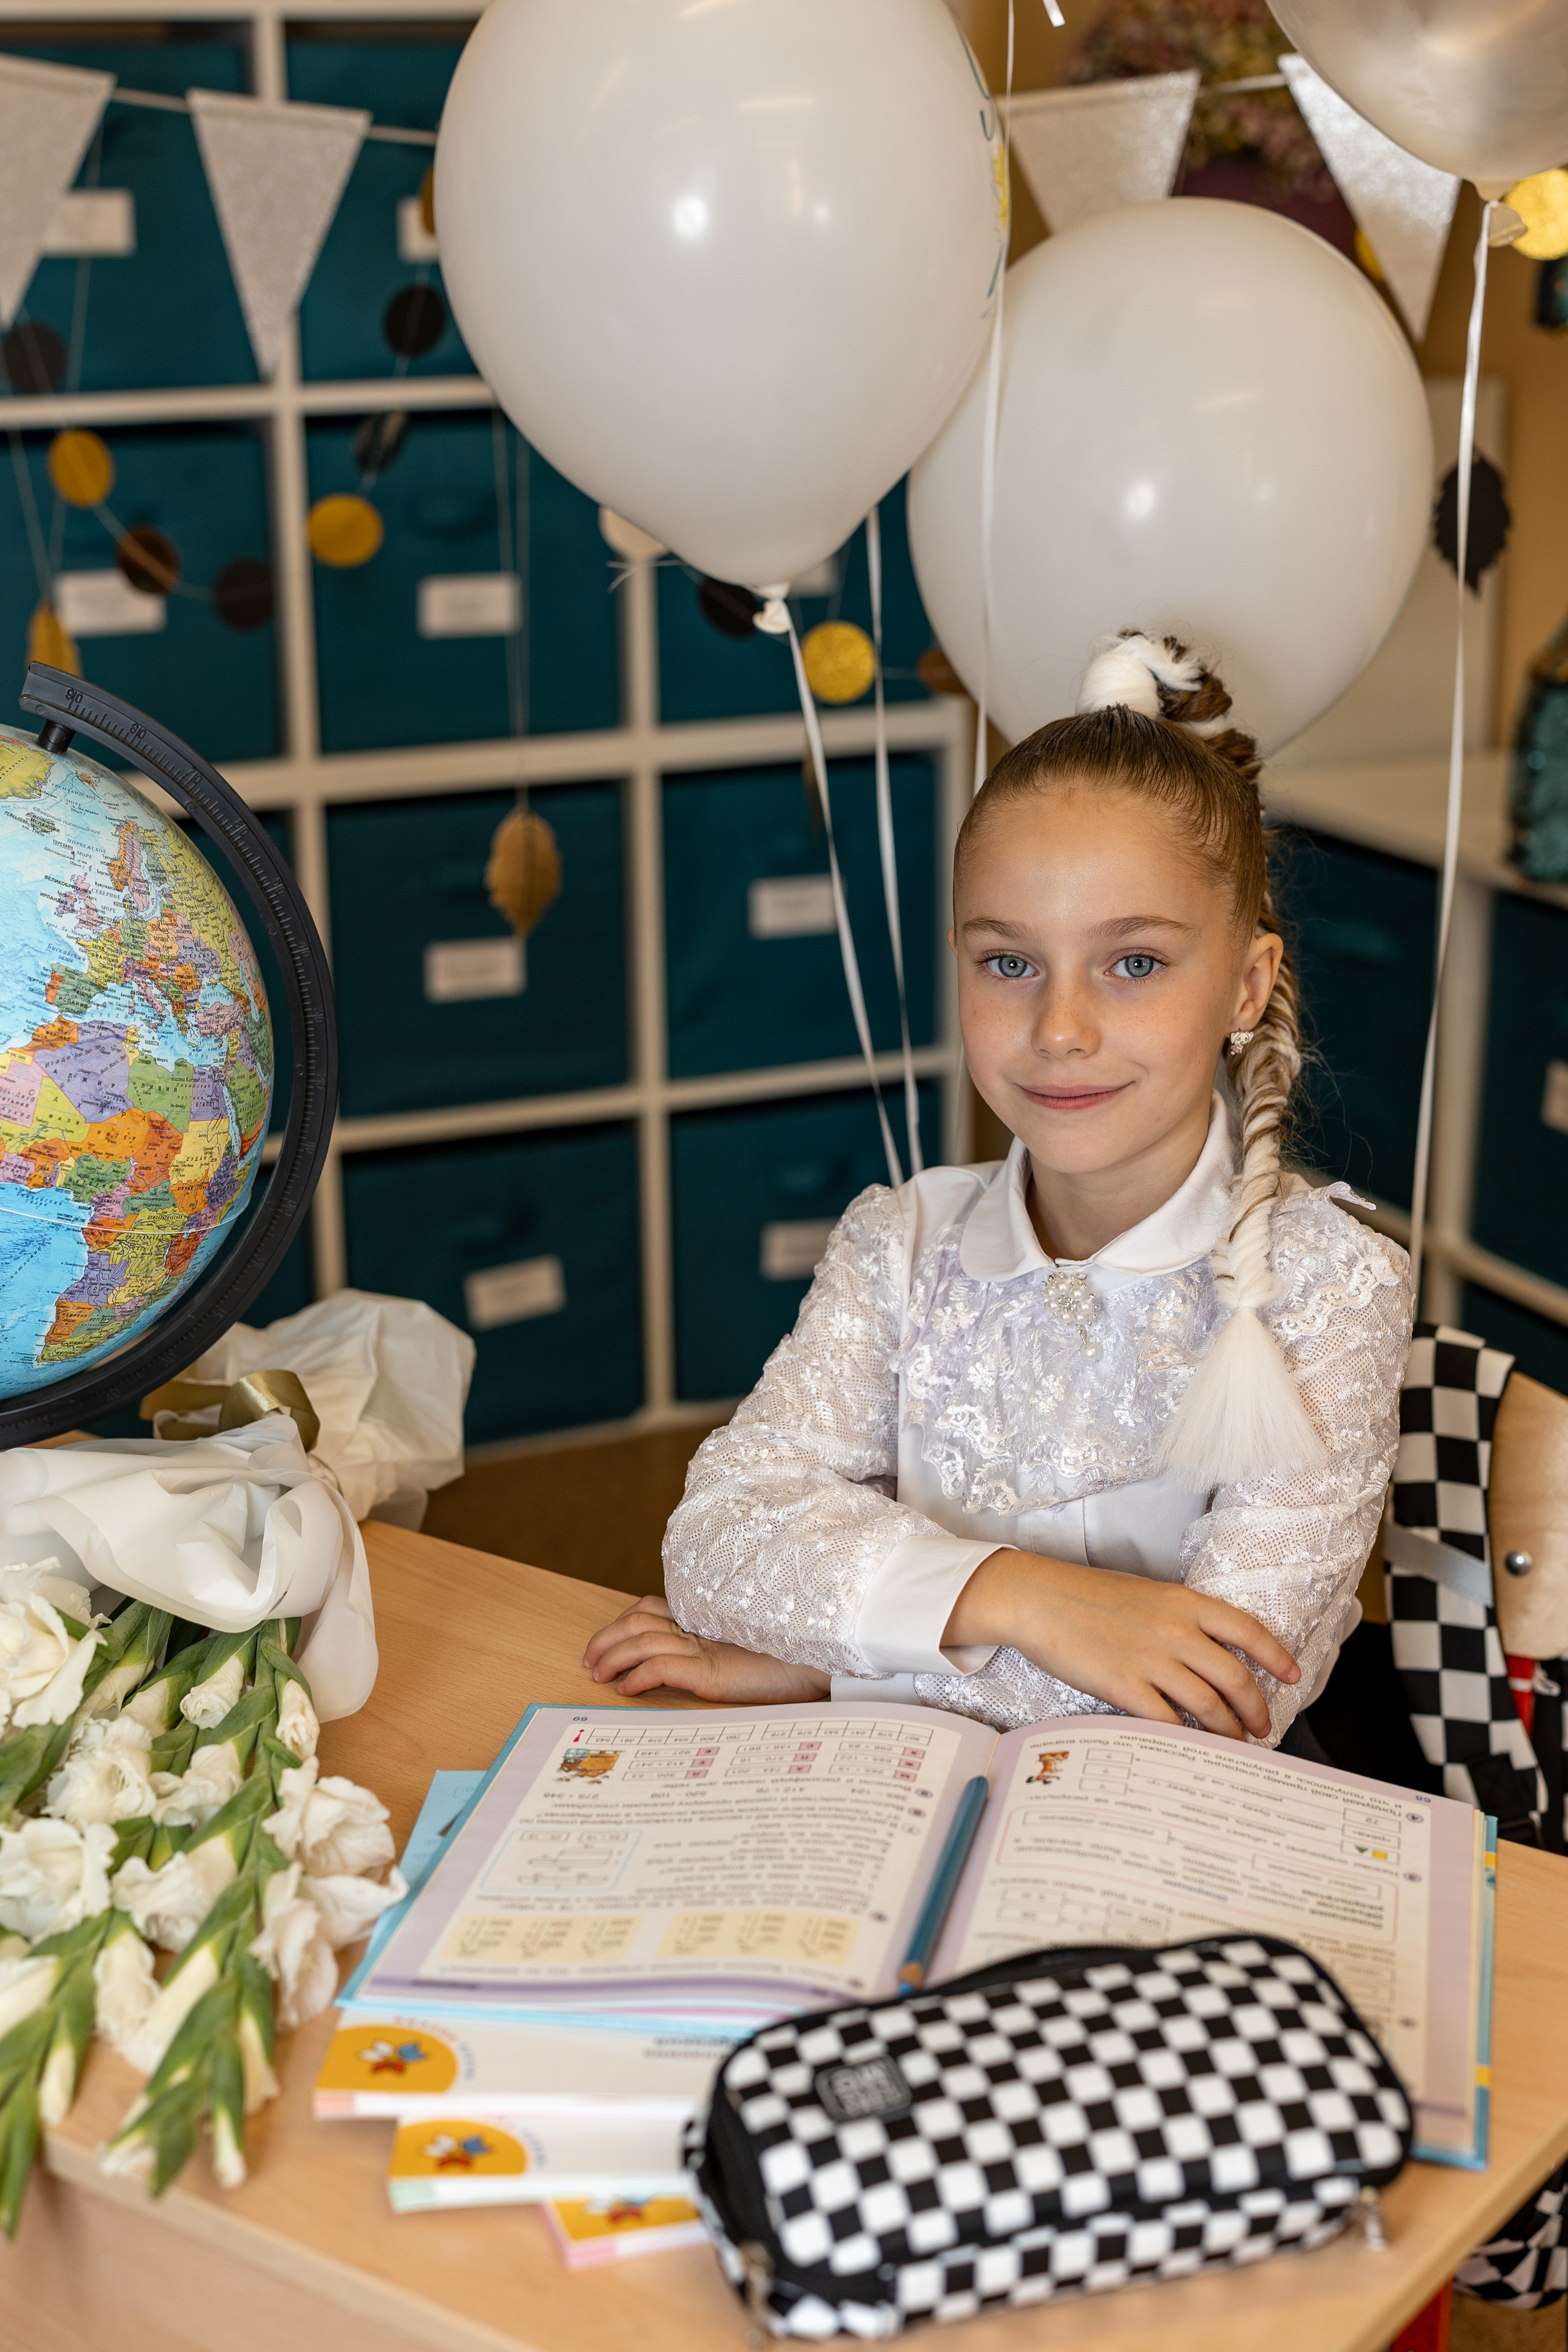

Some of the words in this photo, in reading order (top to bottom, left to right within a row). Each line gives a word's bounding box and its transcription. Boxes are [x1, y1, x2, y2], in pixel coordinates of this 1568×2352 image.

[66, 688, 83, 704] 90
[129, 722, 146, 740] 80
[185, 767, 201, 786] 70
[51, 783, 96, 801] ГРЕНЛАНДСКОЕ
[66, 799, 82, 807] МОРЕ
[4, 810, 28, 825] РЕЙКЬЯВИК
[31, 818, 60, 834] ИСЛАНДИЯ
[63, 820, 89, 832] полярный
[53, 839, 74, 850] ТОРСХАВН
[67, 839, 107, 854] НОРВЕЖСКОЕ
[77, 851, 92, 859] МОРЕ
[100, 861, 124, 870] НОРВЕГИЯ
[44, 875, 92, 895] ВЕЛИКОБРИТАНИЯ
[40, 892, 68, 905] ИРЛАНДИЯ
[91, 888, 121, 900] СЕВЕРНОЕ
[101, 905, 116, 914] МОРЕ
[47, 943, 86, 962] Бискайский
[91, 953, 119, 964] ФРАНЦИЯ
[59, 997, 89, 1009] ИСПАНИЯ
[216, 1020, 239, 1031] ТУРЦИЯ
[141, 1083, 177, 1093] ЛИВИЯ
[49, 1114, 80, 1125] МАЛИ
[97, 1130, 136, 1141] НИГЕР
[1117, 1734, 1177, 1750] операции.
[1137, 1743, 1196, 1762] Расскажи,
[1183, 1746, 1210, 1757] этой
[1200, 1757, 1259, 1778] операции.
[1215, 1754, 1280, 1776] результате
[1263, 1775, 1307, 1792] пример
[1296, 1777, 1364, 1800] получилось
[1311, 1789, 1339, 1800] свой
[1415, 1794, 1431, 1804] 68
[1343, 1797, 1401, 1817] Придумай
[1370, 1797, 1389, 1806] что
